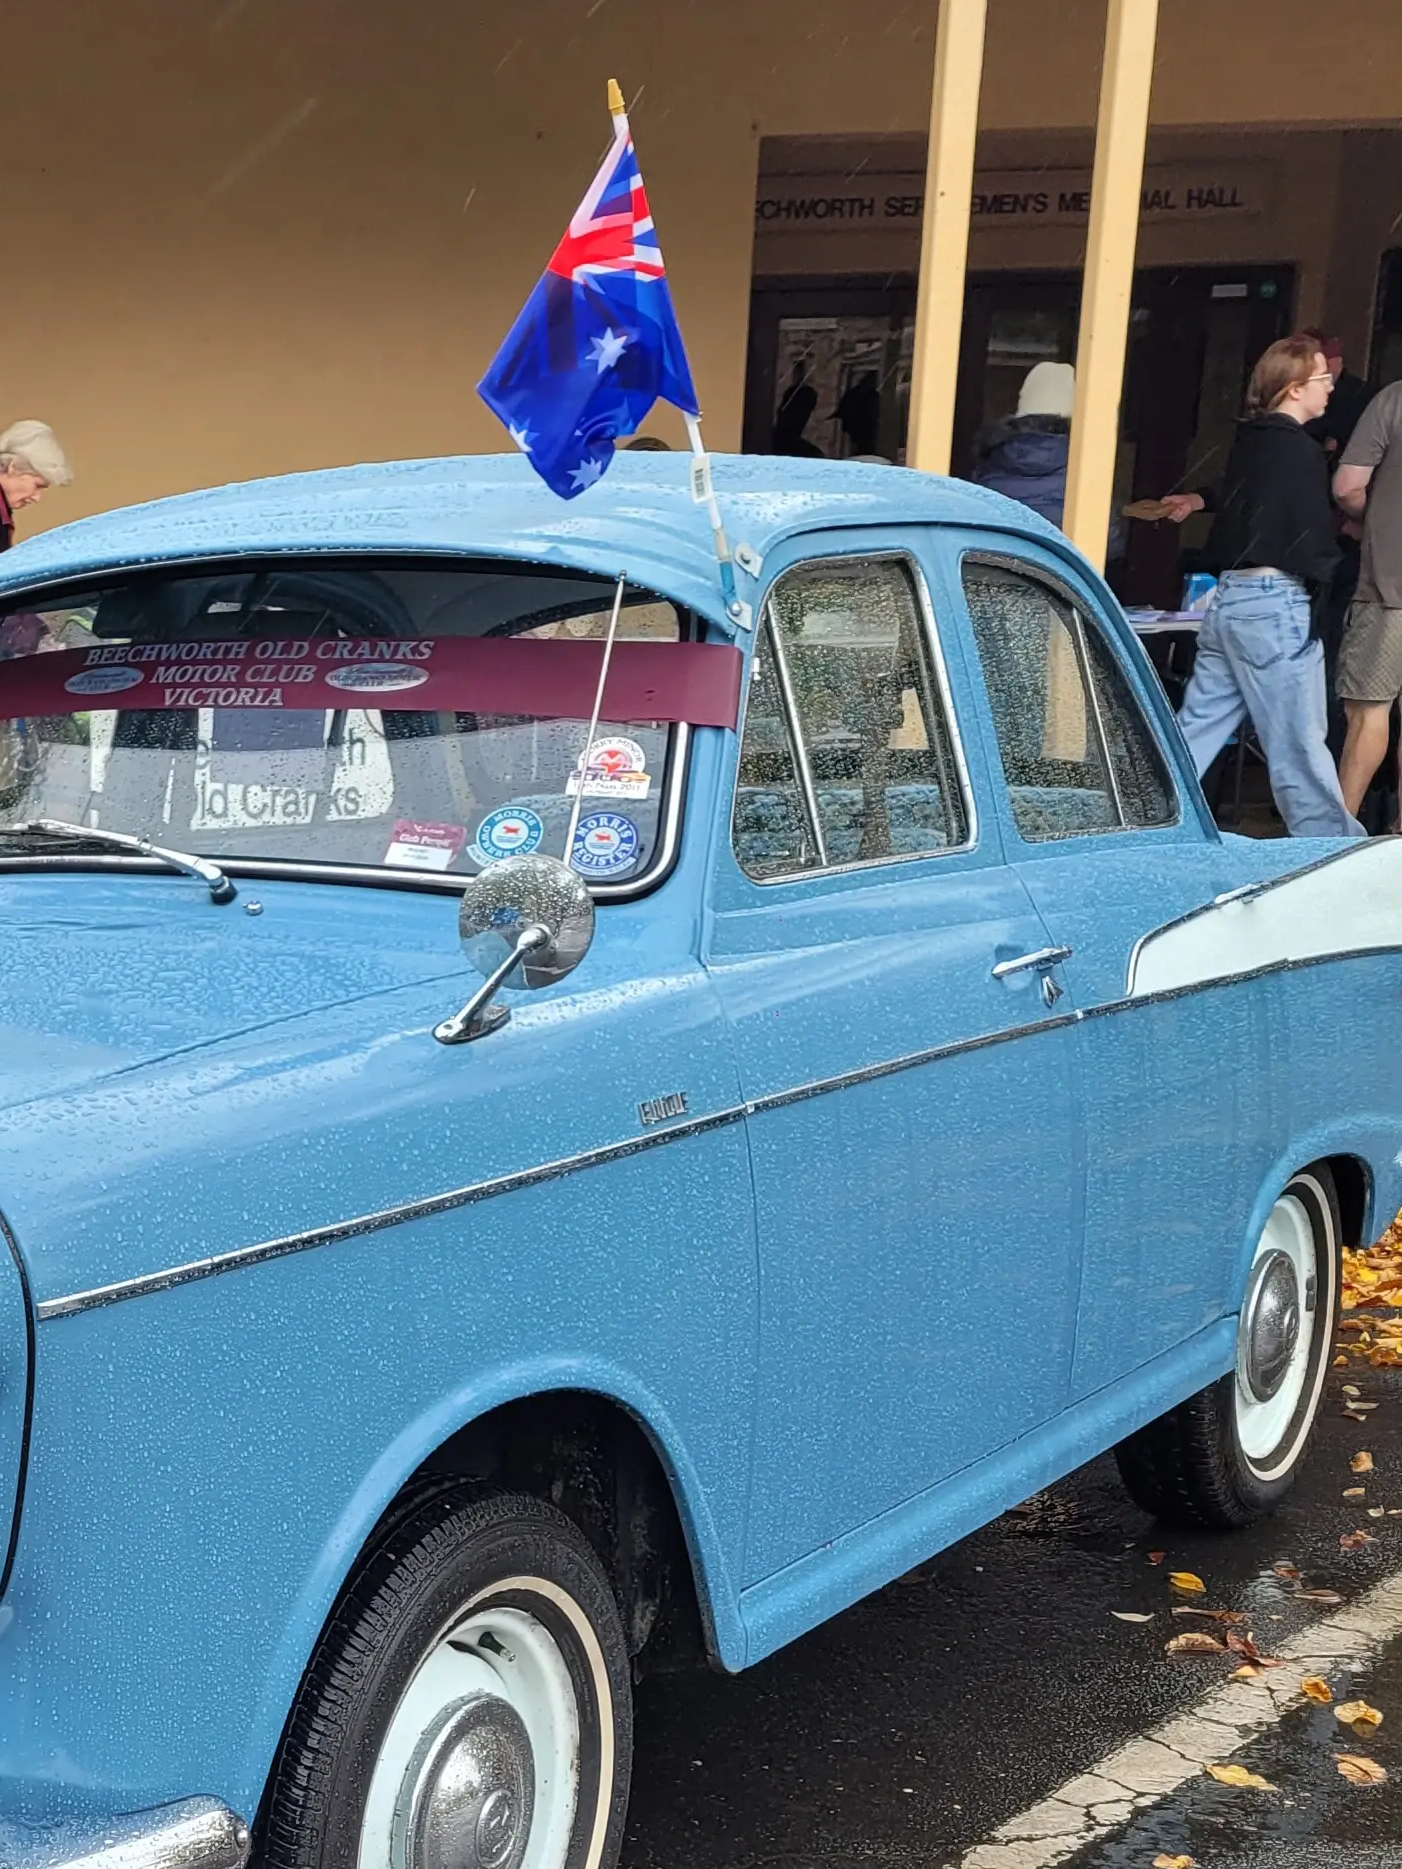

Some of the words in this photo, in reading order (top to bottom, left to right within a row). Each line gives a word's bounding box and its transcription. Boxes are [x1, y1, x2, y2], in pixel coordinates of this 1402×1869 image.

[755, 196, 875, 220] CHWORTH
[1058, 186, 1177, 213] MEIAL
[1186, 187, 1244, 210] HALL
[83, 641, 251, 666] BEECHWORTH
[254, 640, 309, 660] OLD
[315, 640, 435, 661] CRANKS
[149, 664, 240, 684] MOTOR
[245, 664, 317, 683] CLUB
[163, 687, 284, 706] VICTORIA
[494, 810, 538, 827] MORRIS
[576, 816, 633, 838] MORRIS
[573, 842, 634, 867] REGISTER
